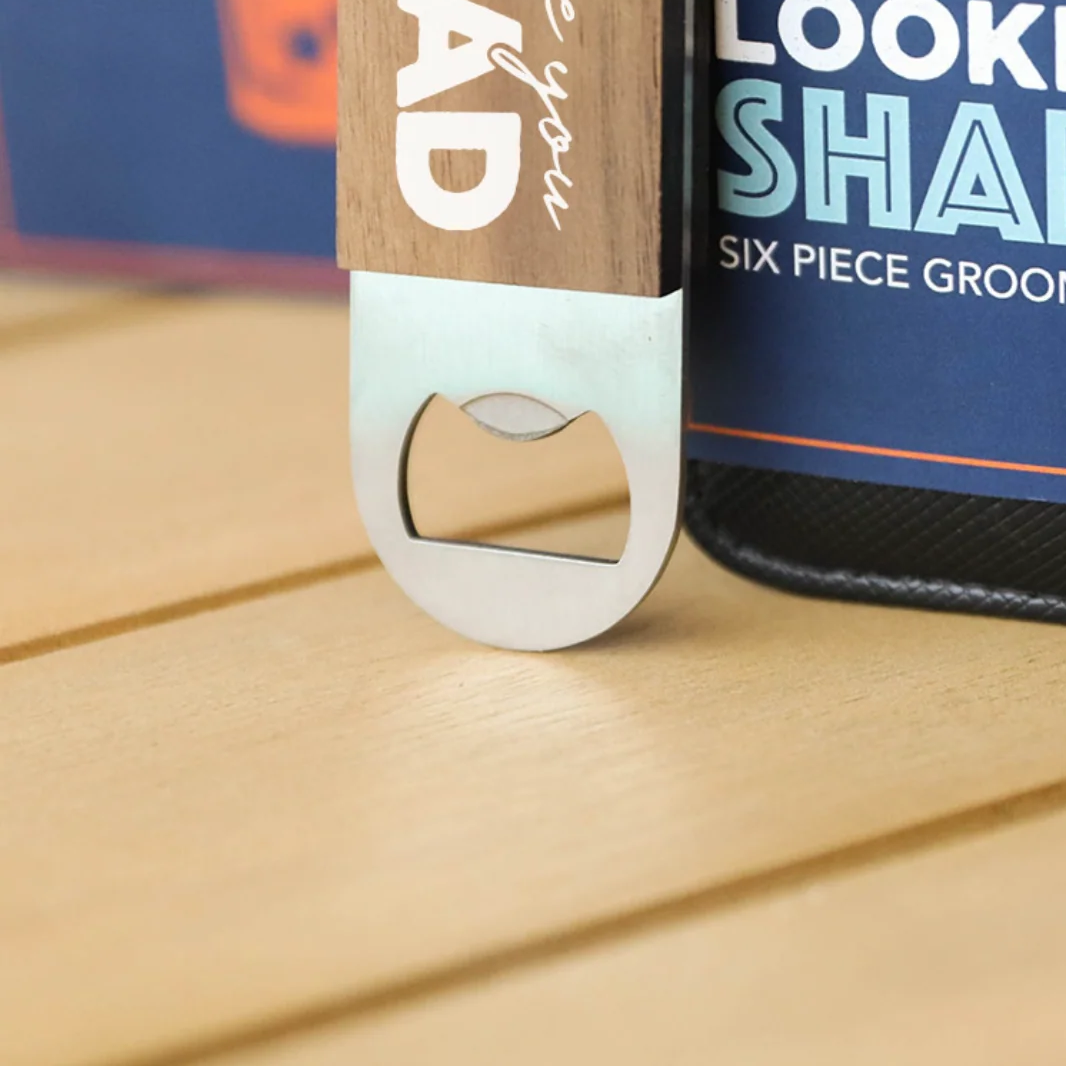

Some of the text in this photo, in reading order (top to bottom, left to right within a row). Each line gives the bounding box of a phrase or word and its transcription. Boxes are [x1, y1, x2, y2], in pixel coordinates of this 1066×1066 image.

[487, 28, 574, 230] you
[719, 236, 780, 275] SIX
[793, 243, 909, 289] PIECE
